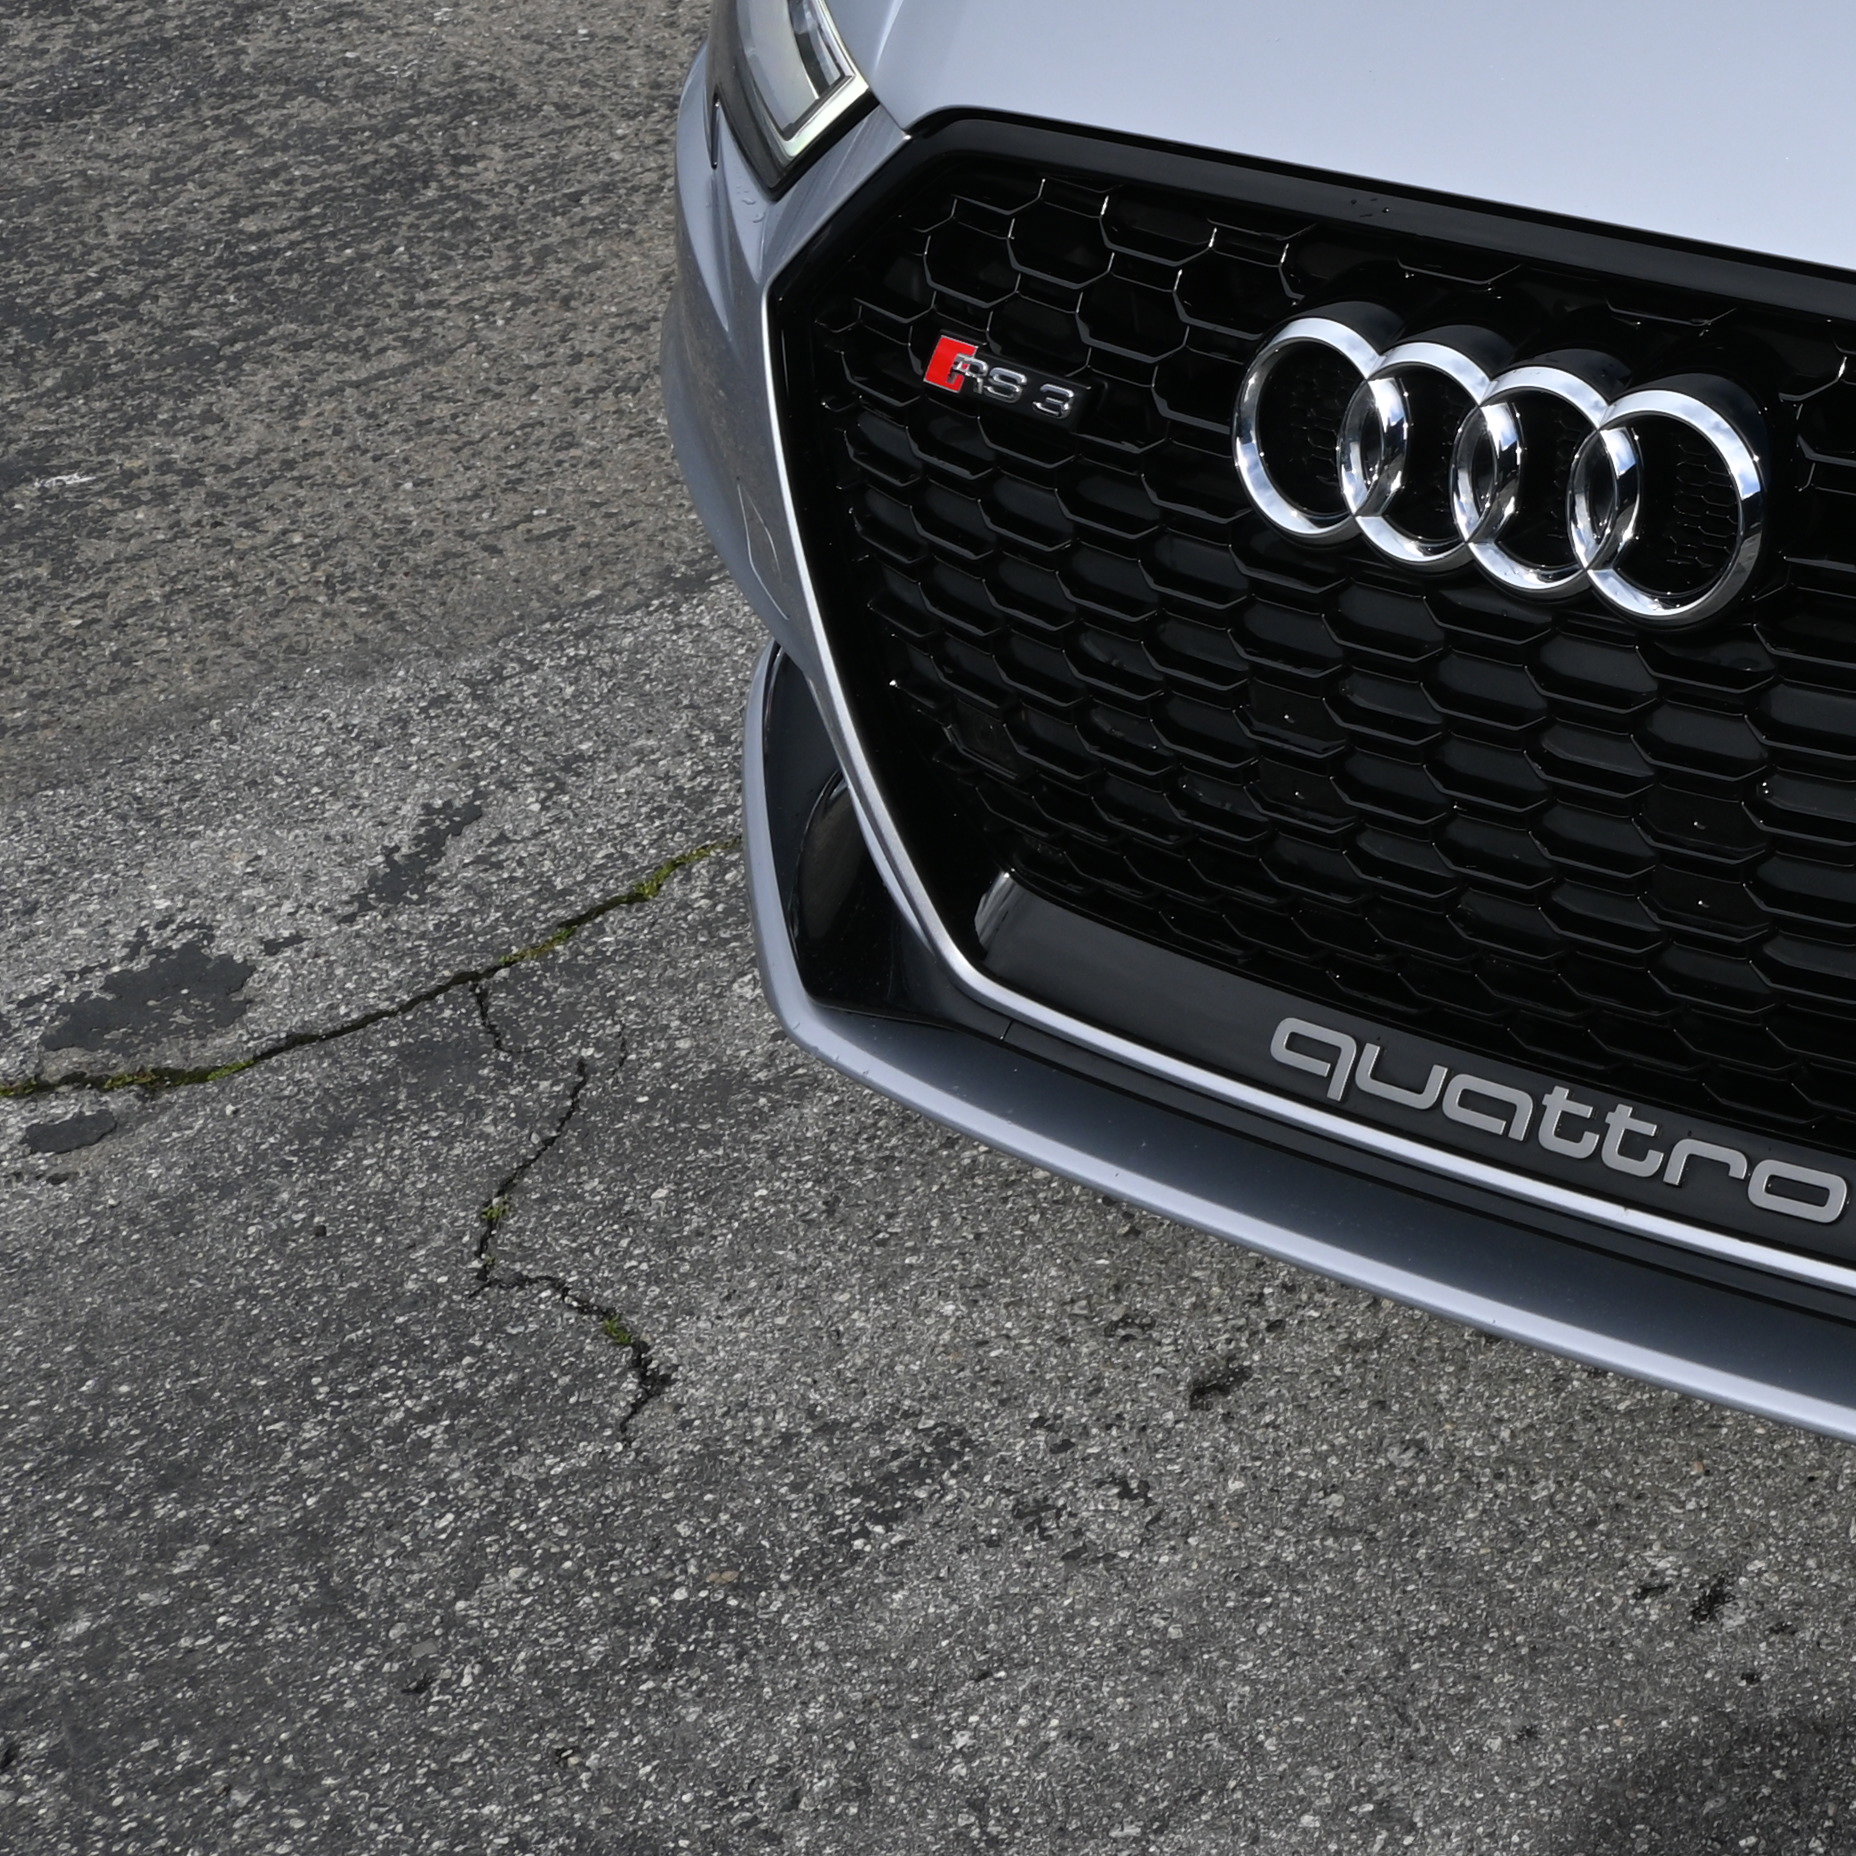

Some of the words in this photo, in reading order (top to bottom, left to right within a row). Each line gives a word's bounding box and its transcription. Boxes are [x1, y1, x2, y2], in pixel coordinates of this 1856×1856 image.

[945, 352, 1029, 404] RS
[1031, 382, 1075, 420] 3
[1269, 1016, 1849, 1225] quattro
